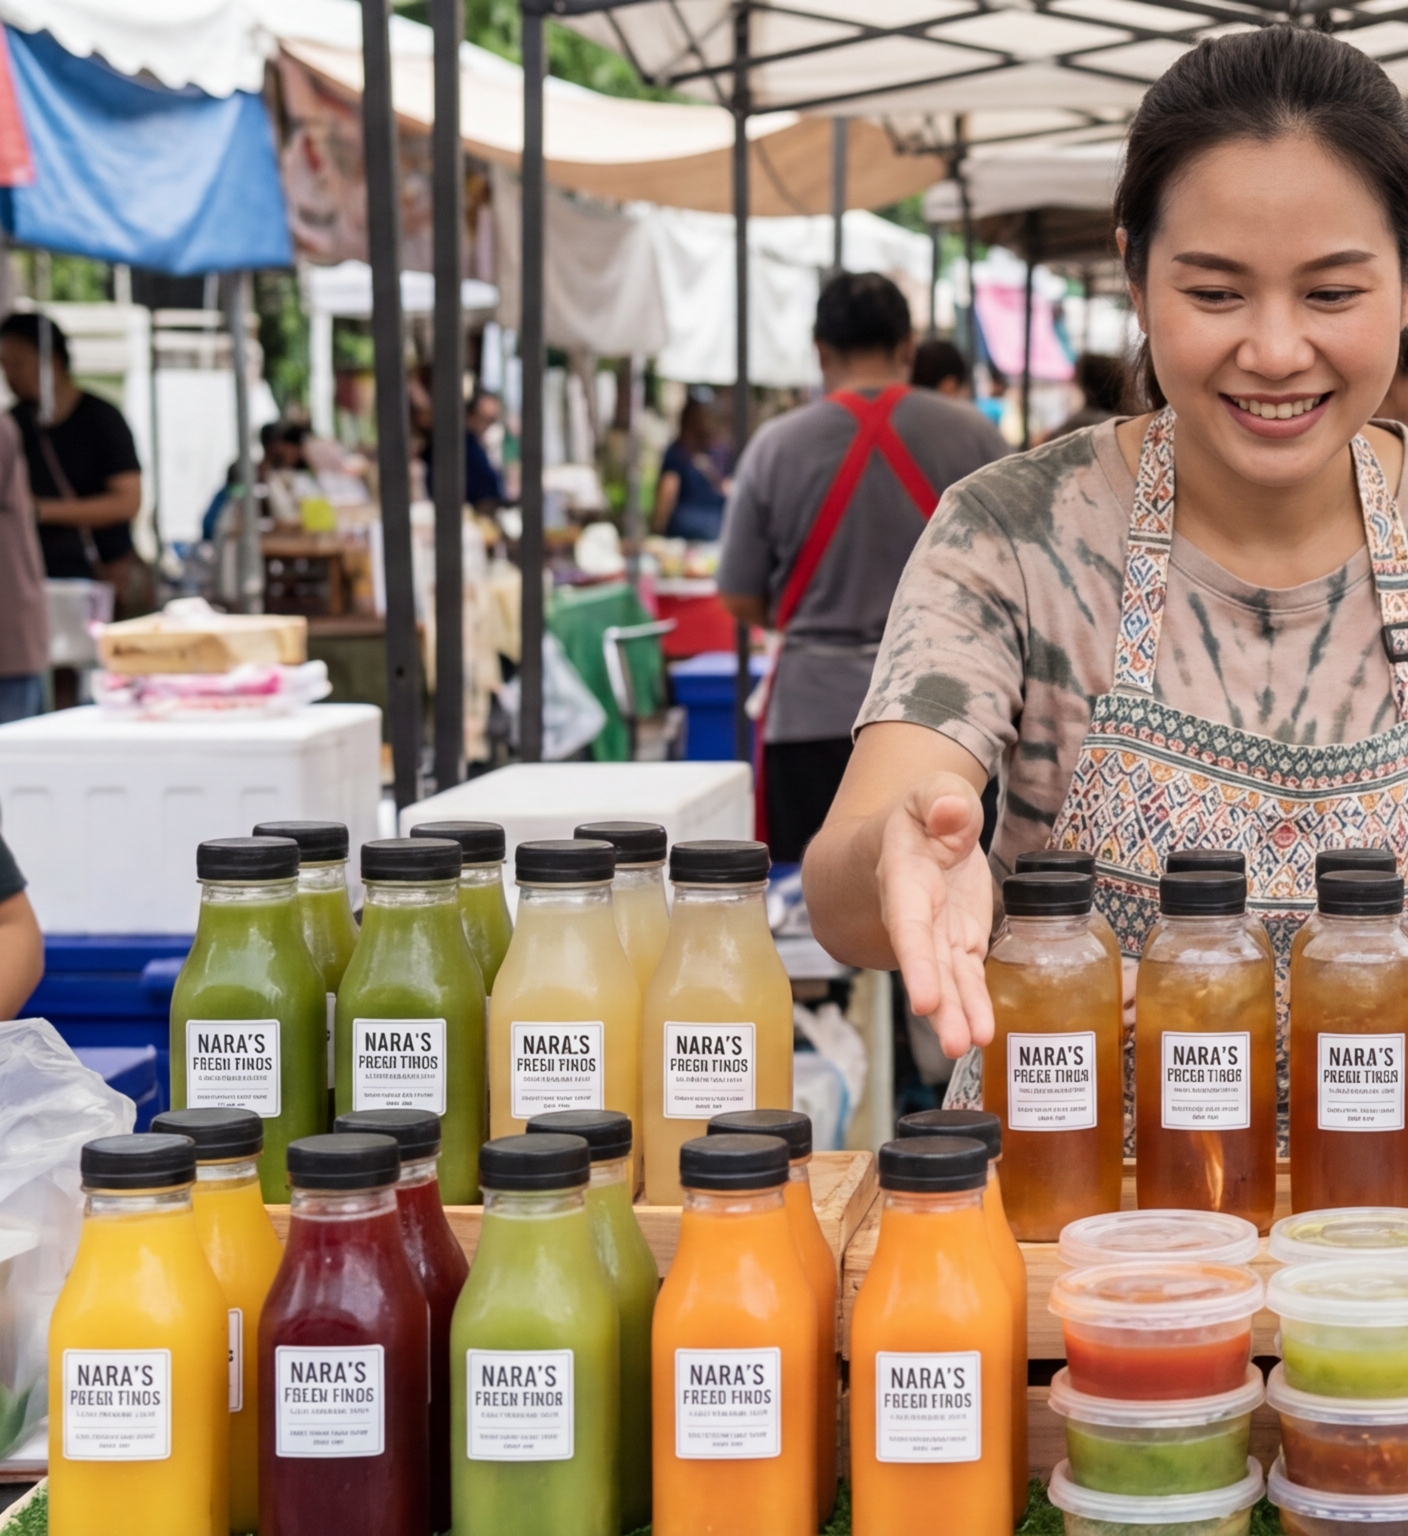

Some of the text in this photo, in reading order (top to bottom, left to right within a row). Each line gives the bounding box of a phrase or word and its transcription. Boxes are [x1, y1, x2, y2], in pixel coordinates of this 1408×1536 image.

[198, 1034, 265, 1054] NARA'S
[365, 1032, 431, 1051] NARA'S
[523, 1035, 590, 1055] NARA'S
[677, 1036, 742, 1055] NARA'S
[1020, 1046, 1083, 1066] NARA'S
[1174, 1046, 1237, 1065] NARA'S
[1330, 1047, 1393, 1066] NARA'S
[78, 1365, 153, 1386] NARA'S
[291, 1362, 366, 1383] NARA'S
[482, 1365, 556, 1387] NARA'S
[690, 1364, 764, 1385] NARA'S
[891, 1367, 965, 1389] NARA'S
